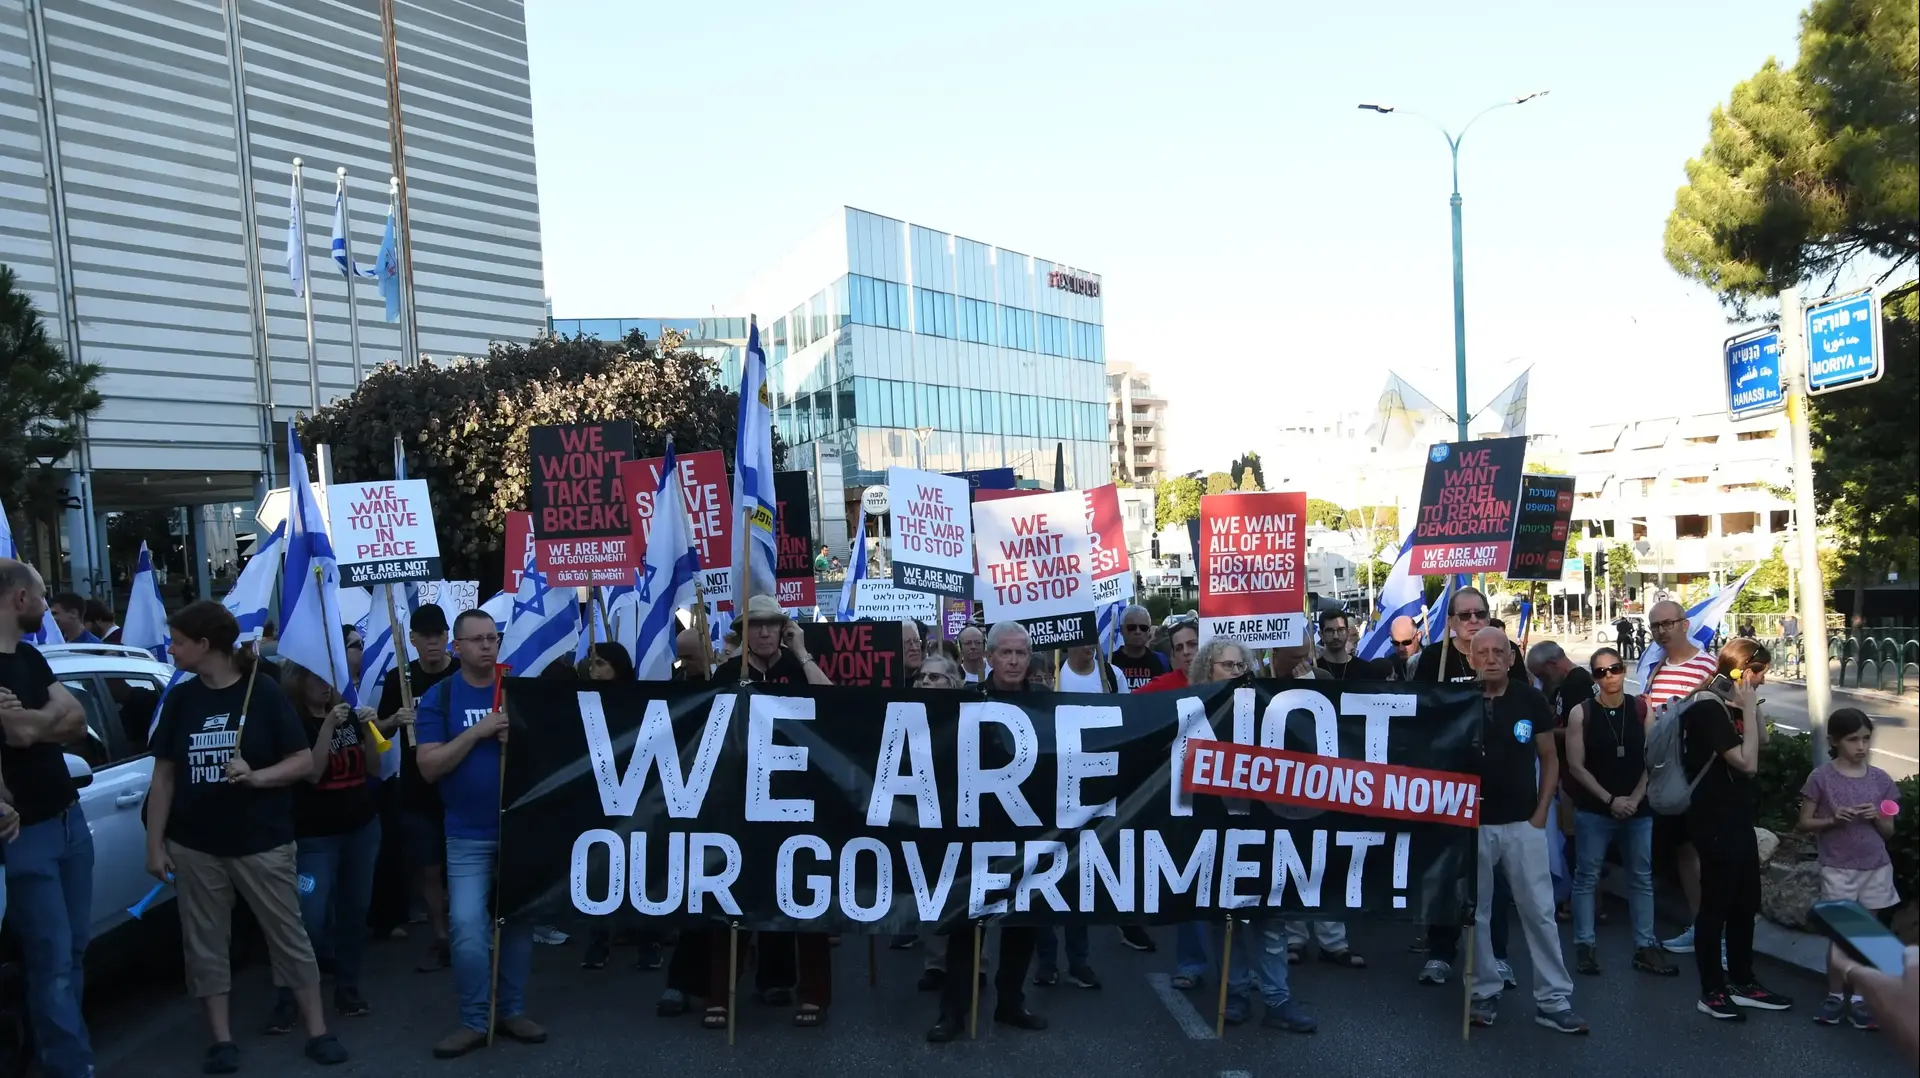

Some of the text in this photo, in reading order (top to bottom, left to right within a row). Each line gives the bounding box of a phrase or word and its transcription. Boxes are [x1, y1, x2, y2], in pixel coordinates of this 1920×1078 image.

[1813, 353, 1856, 376] MORIYA
[1733, 387, 1765, 407] HANASSI
[559, 427, 604, 451] WE
[538, 451, 625, 479] WON'T
[1459, 449, 1491, 467] WE
[1444, 466, 1500, 487] WANT
[361, 485, 396, 500] WE
[542, 478, 625, 505] TAKE A
[917, 484, 943, 504] WE
[1439, 485, 1496, 505] ISRAEL
[1529, 488, 1556, 498] מערכת
[350, 499, 409, 515] WANT
[907, 500, 953, 522] WANT
[1422, 501, 1512, 522] TO REMAIN
[1525, 503, 1555, 512] המשפט
[347, 512, 418, 530] TO LIVE
[543, 503, 628, 532] BREAK!
[1011, 513, 1049, 537] WE
[1210, 514, 1297, 534] WE WANT
[375, 528, 395, 542] IN
[897, 515, 964, 542] THE WAR
[1417, 518, 1511, 537] DEMOCRATIC
[1519, 524, 1551, 534] הביטחון
[357, 541, 417, 559] PEACE
[548, 540, 625, 556] WE ARE NOT
[901, 533, 963, 558] TO STOP
[1000, 534, 1063, 560] WANT
[1210, 532, 1296, 553] ALL OF THE
[549, 553, 627, 565] OUR GOVERNMENT!
[1424, 546, 1498, 561] WE ARE NOT
[1515, 553, 1545, 569] אסון
[351, 560, 428, 575] WE ARE NOT
[987, 561, 1028, 585] THE
[1032, 554, 1082, 579] WAR
[1209, 553, 1295, 574] HOSTAGES
[1422, 558, 1496, 569] OUR GOVERNMENT!
[352, 569, 430, 582] OUR GOVERNMENT!
[558, 573, 573, 581] OUR
[706, 572, 729, 586] NOT
[903, 566, 964, 586] WE ARE NOT
[904, 577, 964, 593] OUR GOVERNMENT!
[1099, 578, 1120, 592] NOT
[1209, 571, 1294, 592] BACK NOW!
[780, 582, 802, 594] NOT
[862, 583, 893, 591] מחקים
[873, 592, 925, 601] בשקט ולאט
[994, 584, 1022, 606] TO
[1026, 577, 1080, 602] STOP
[1029, 617, 1082, 636] ARE NOT
[1213, 618, 1290, 634] WE ARE NOT
[828, 625, 874, 651] WE
[1031, 630, 1084, 645] VERNMENT!
[820, 651, 895, 678] WON'T
[576, 691, 816, 822] WE
[865, 701, 1123, 829] ARE
[1192, 748, 1477, 819] ELECTIONS NOW!
[570, 829, 1411, 922] OUR GOVERNMENT!
